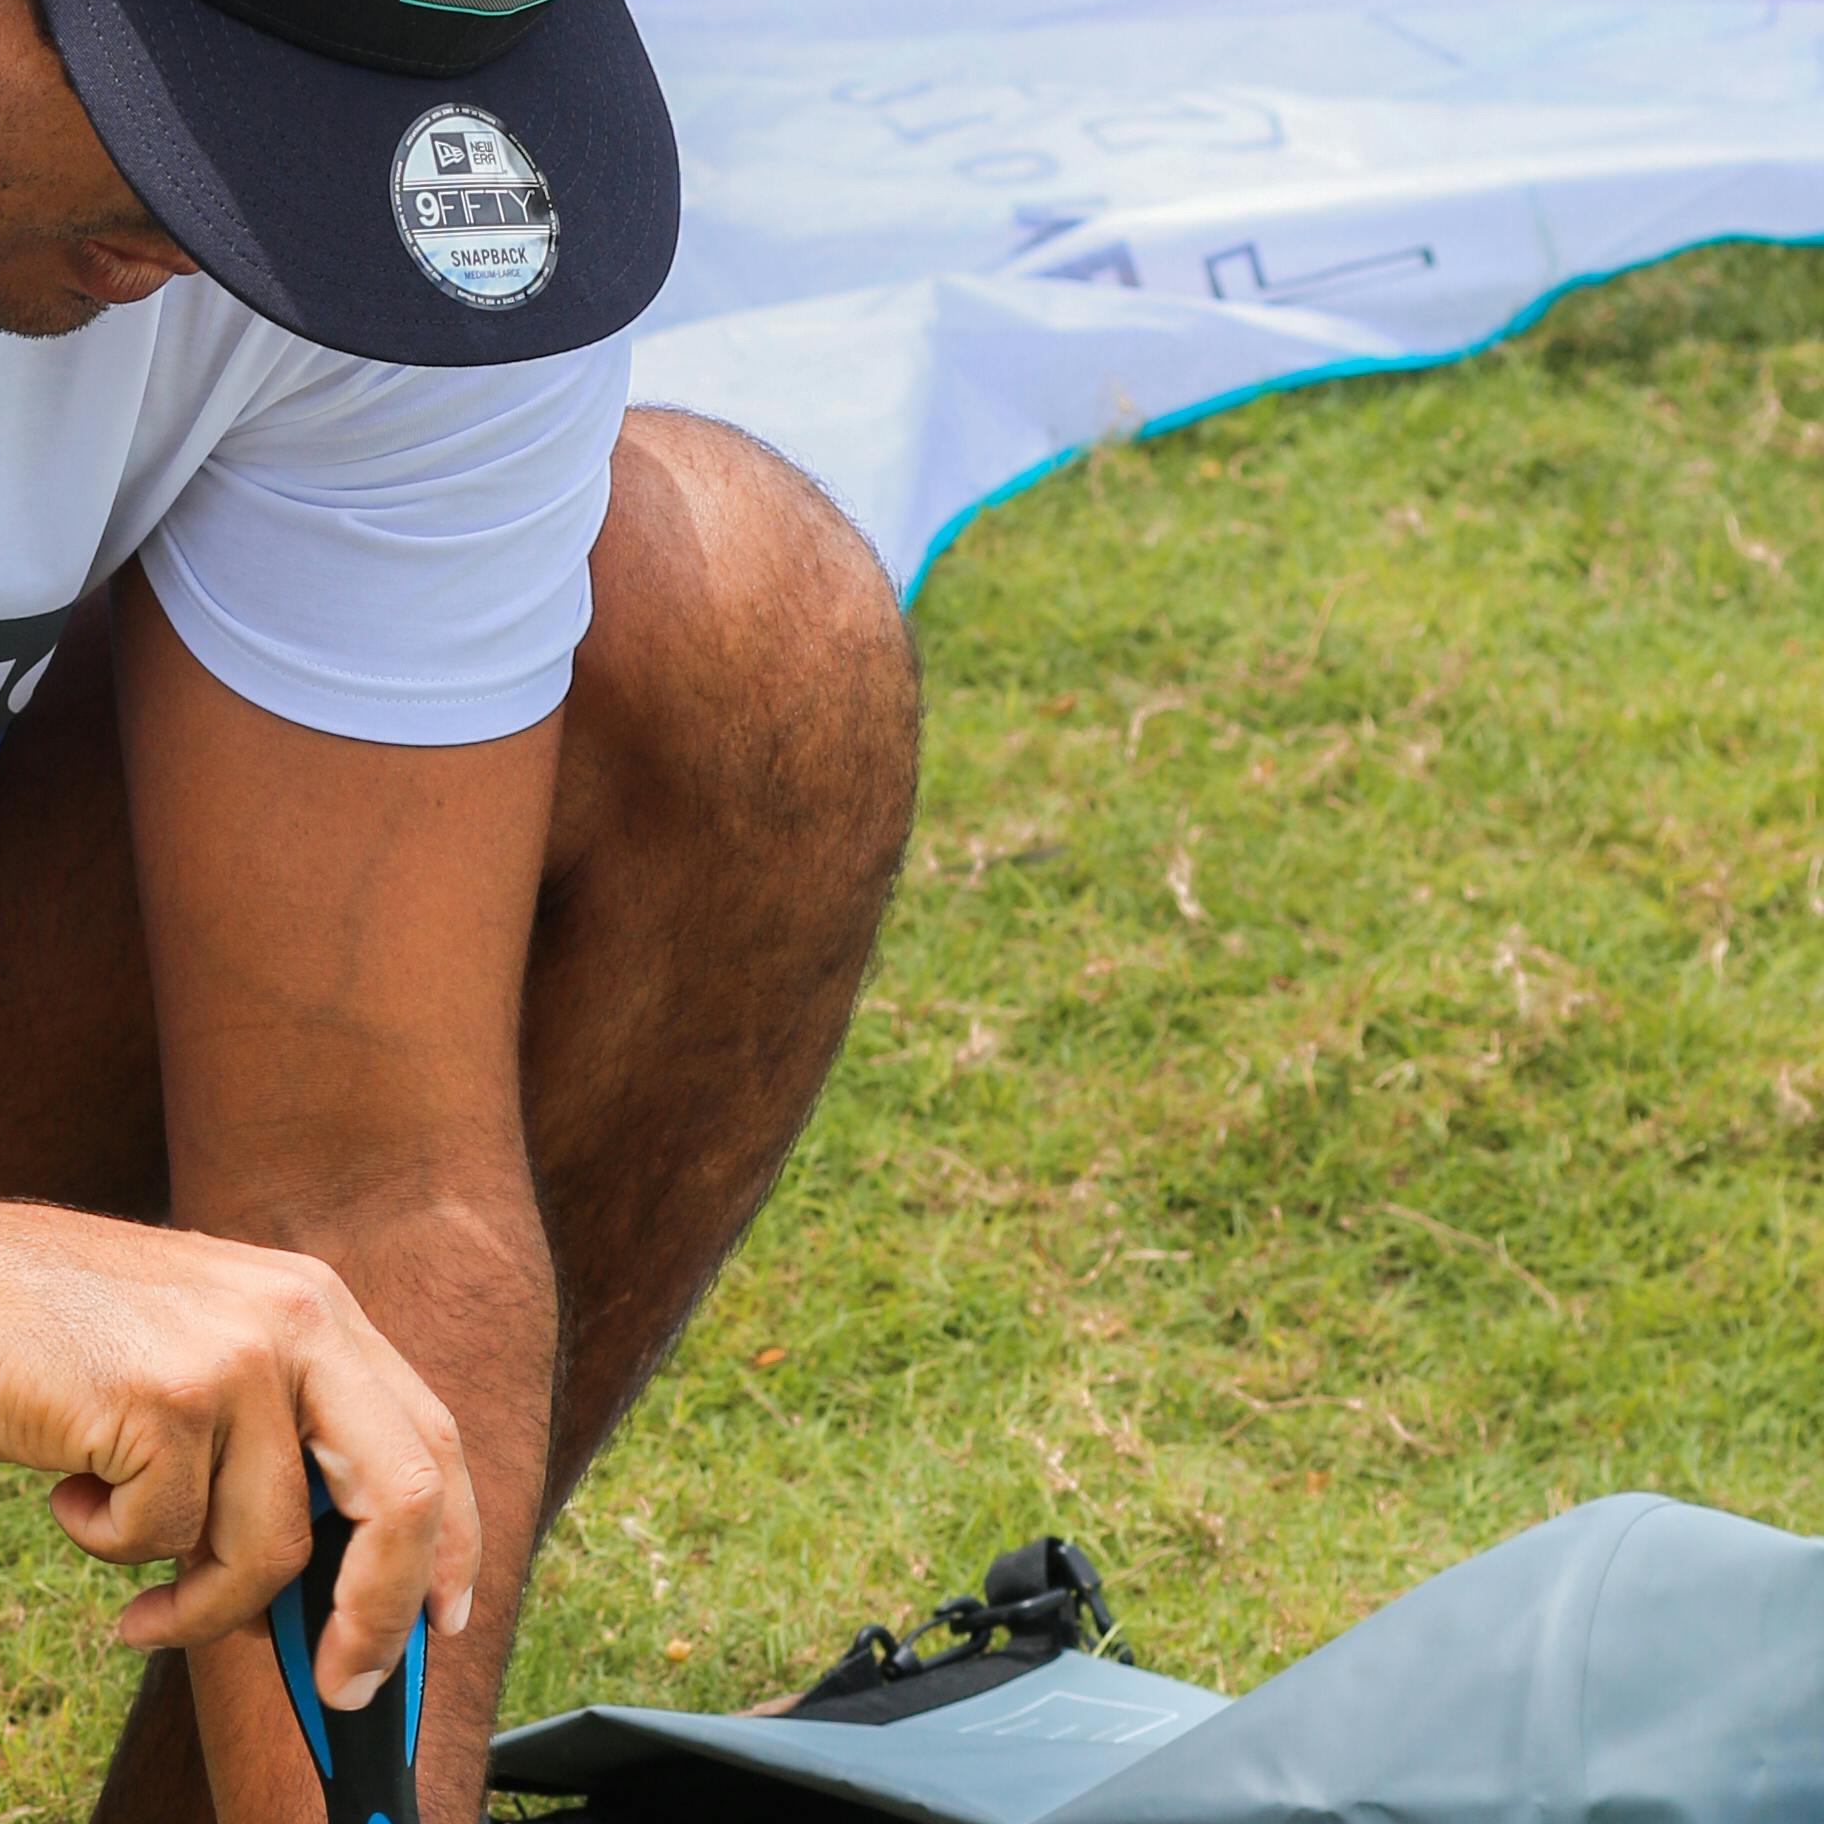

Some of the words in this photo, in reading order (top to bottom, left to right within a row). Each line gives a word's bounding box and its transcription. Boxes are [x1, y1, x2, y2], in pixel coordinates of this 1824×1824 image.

[470, 141, 493, 152] NEW
[473, 153, 496, 165] ERA
[451, 247, 528, 267] SNAPBACK
